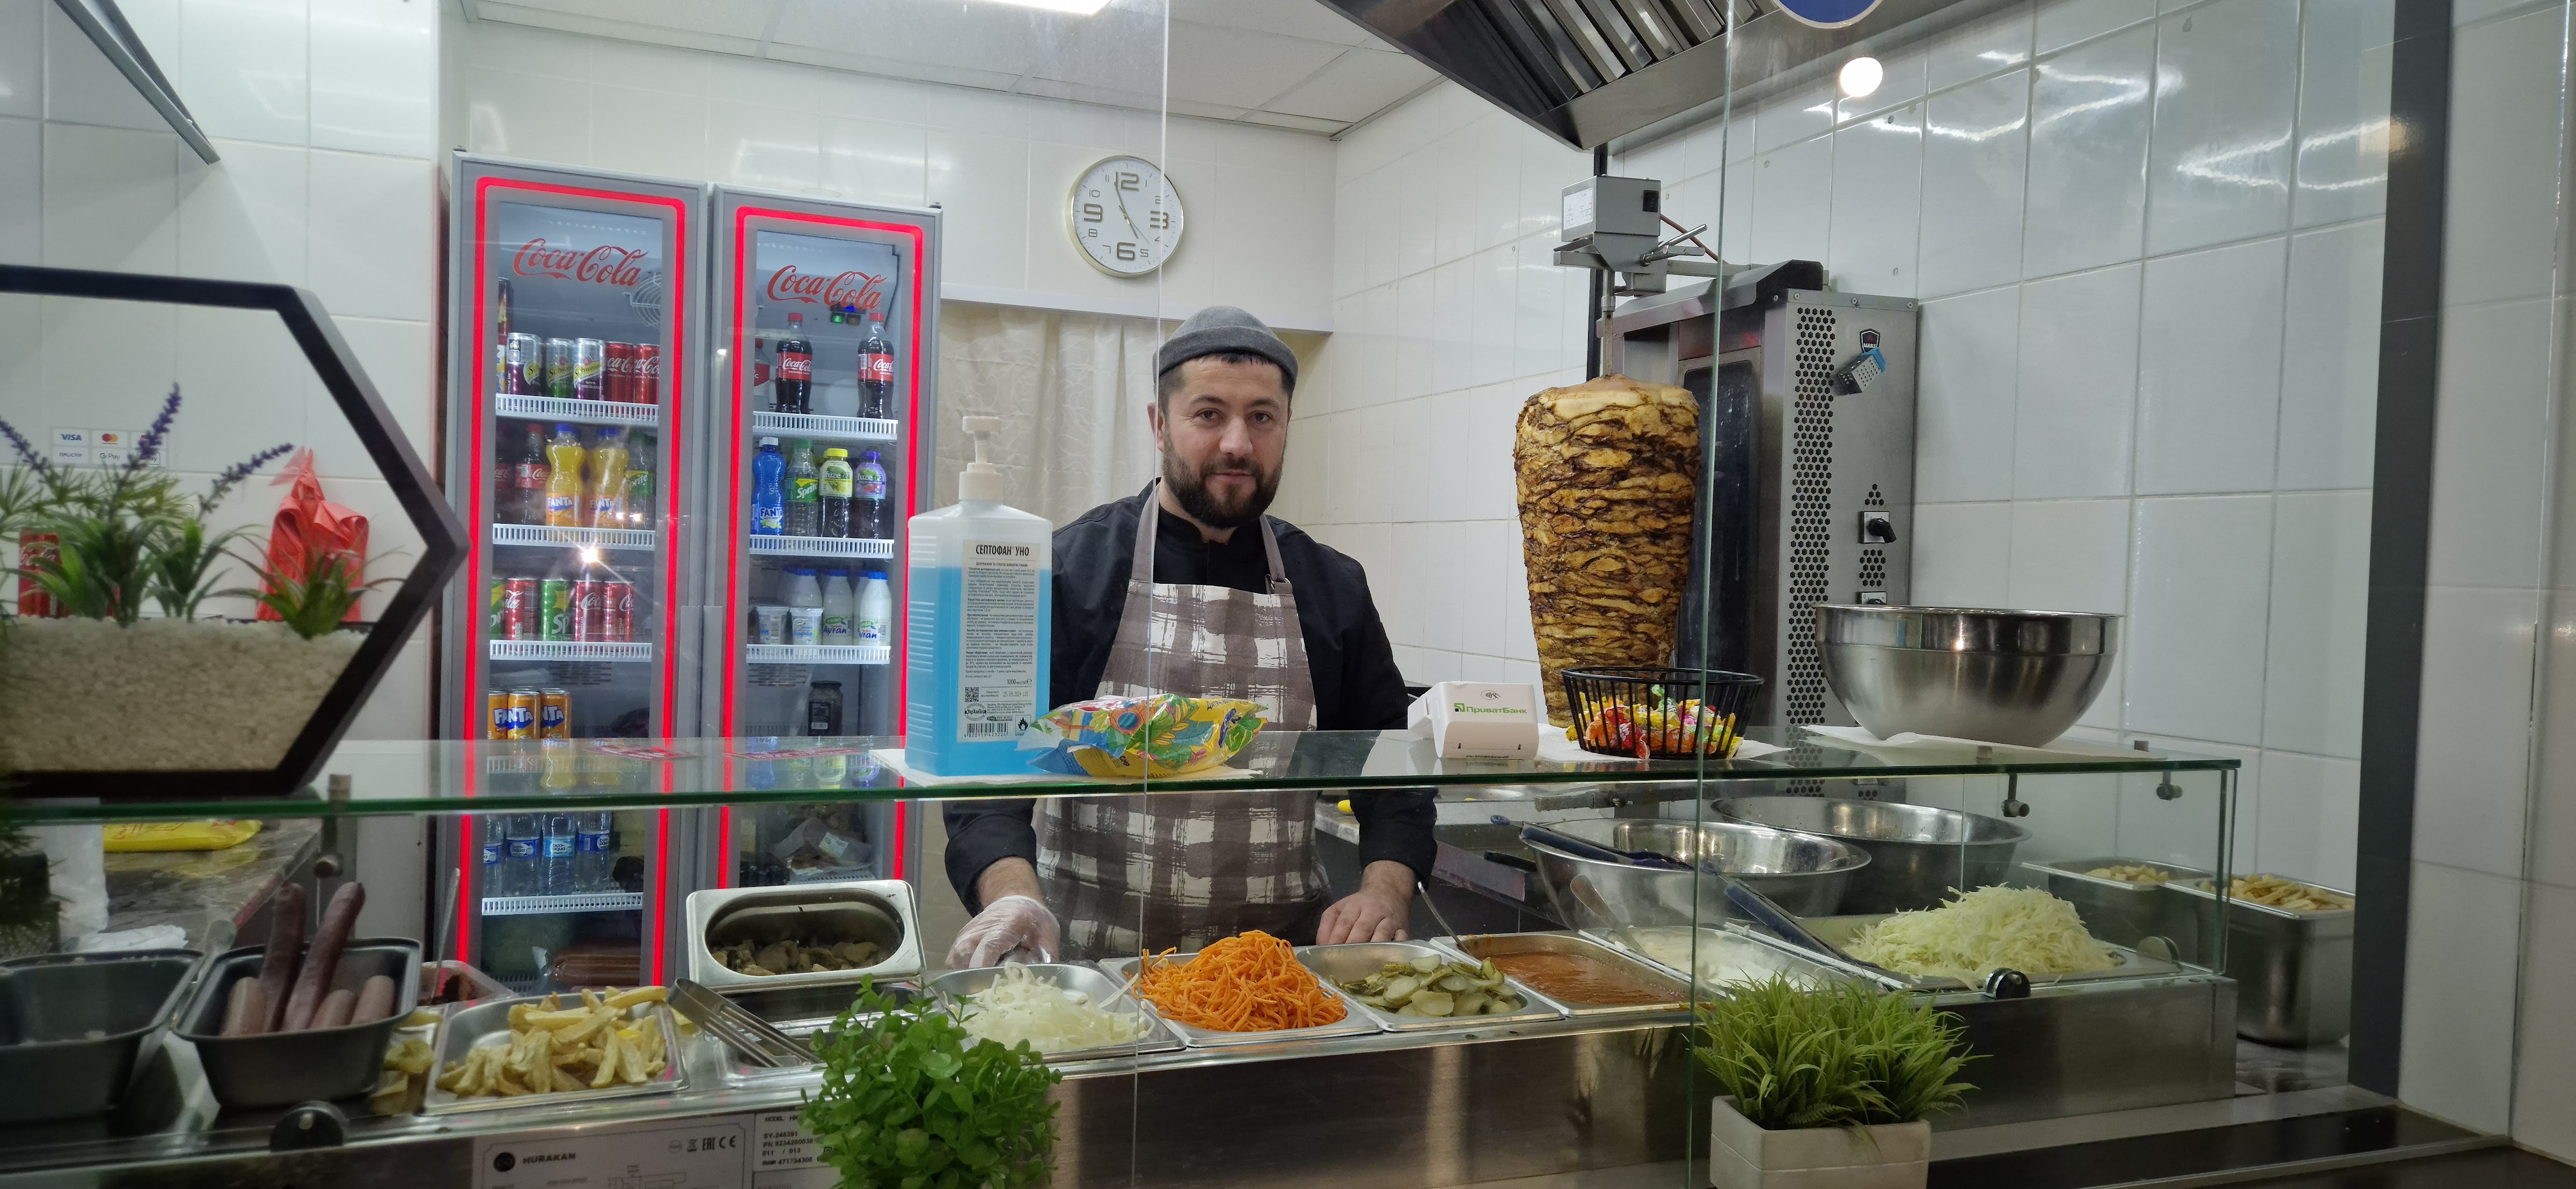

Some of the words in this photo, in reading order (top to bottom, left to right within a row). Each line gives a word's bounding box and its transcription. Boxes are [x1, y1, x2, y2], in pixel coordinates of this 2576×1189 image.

[1084, 203, 1103, 223] 9
[1150, 210, 1169, 229] 3
[1116, 241, 1136, 261] 6
[513, 238, 649, 286] Coca-Cola
[767, 265, 889, 310] Coca-Cola
[825, 471, 841, 479] fuze
[547, 496, 573, 508] FANTA
[976, 544, 1012, 556] СЕПТОФАН
[1015, 546, 1030, 556] УНО
[1466, 706, 1528, 714] ПриватБанк
[522, 1152, 577, 1165] HURAKAN
